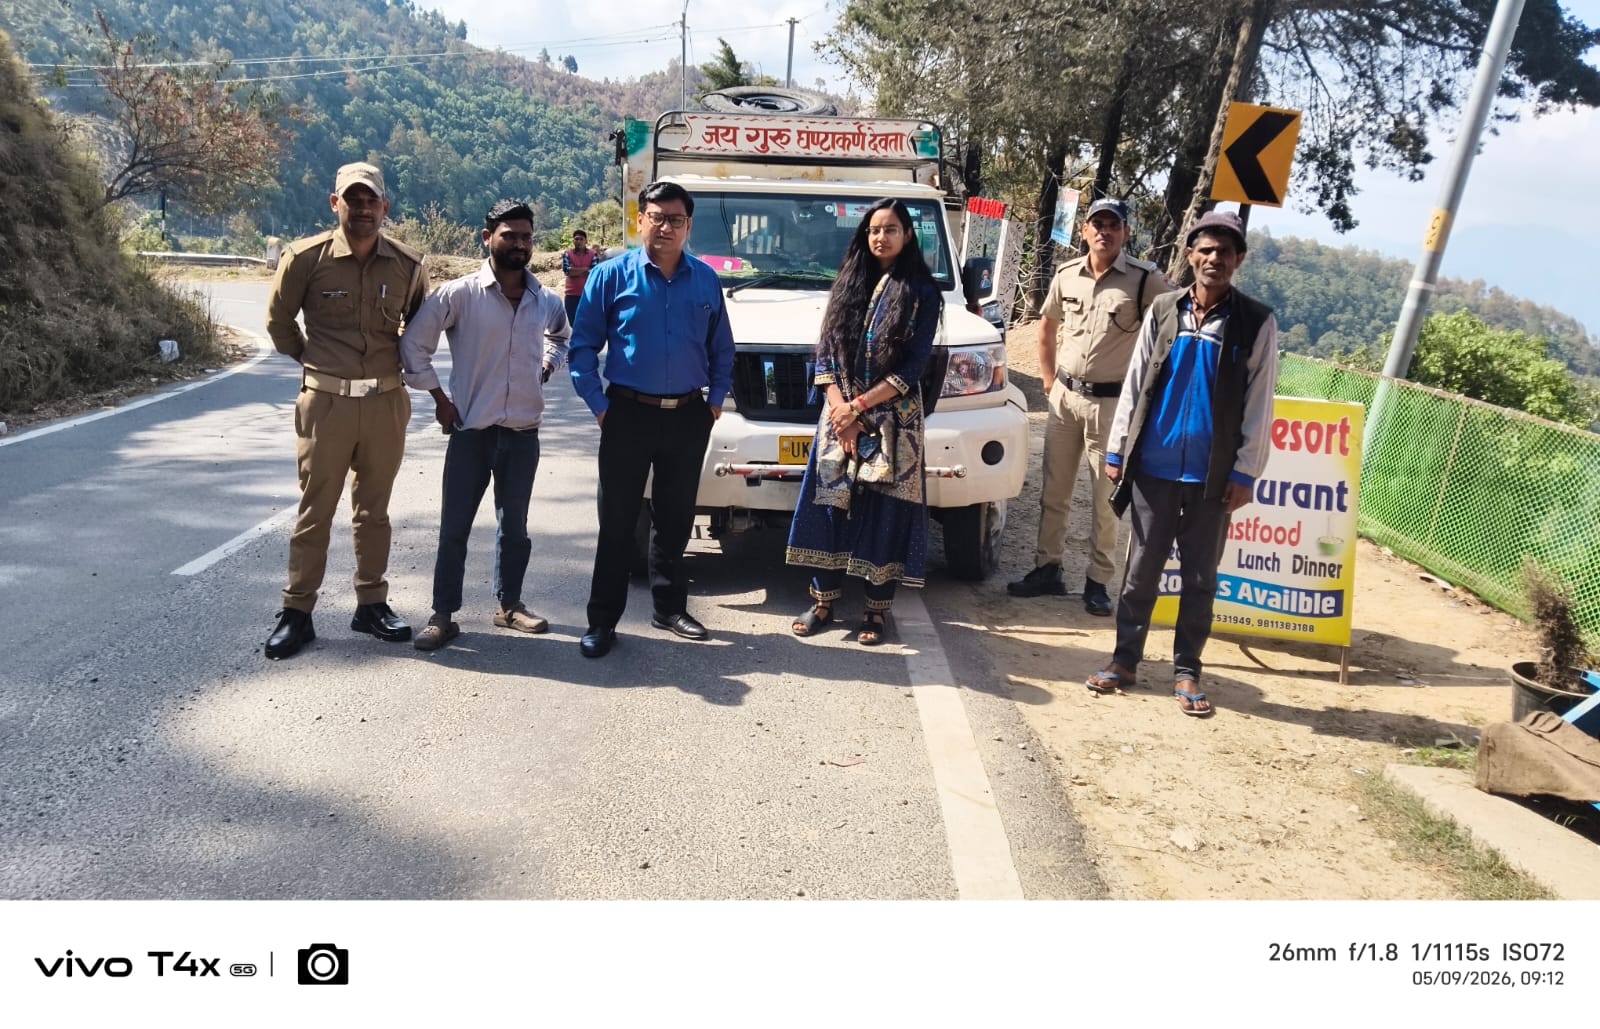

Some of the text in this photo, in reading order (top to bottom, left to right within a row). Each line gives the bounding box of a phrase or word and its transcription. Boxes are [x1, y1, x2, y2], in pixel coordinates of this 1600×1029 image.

[702, 125, 740, 147] जय
[868, 126, 906, 153] देवता
[791, 441, 810, 458] UK
[1271, 416, 1350, 457] esort
[1251, 479, 1349, 512] urant
[1227, 516, 1302, 547] stfood
[1237, 548, 1343, 579] Lunch Dinner
[1237, 582, 1336, 614] Availble
